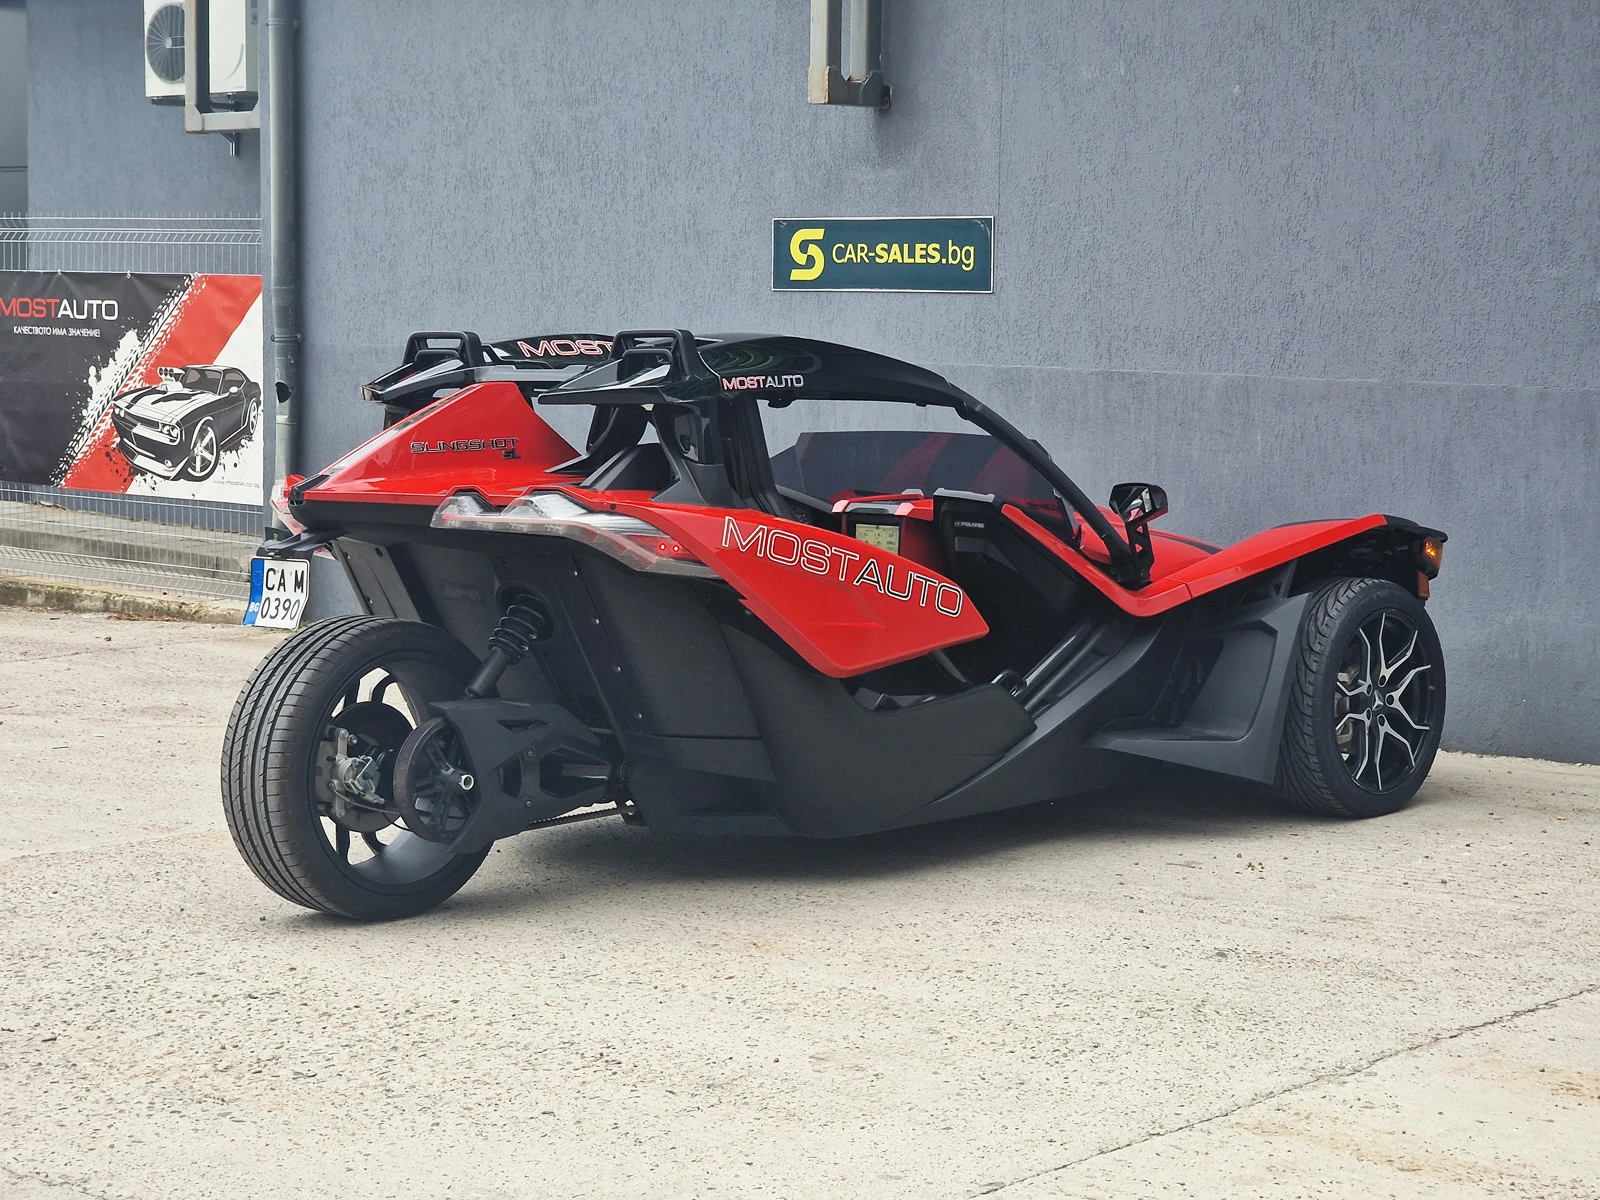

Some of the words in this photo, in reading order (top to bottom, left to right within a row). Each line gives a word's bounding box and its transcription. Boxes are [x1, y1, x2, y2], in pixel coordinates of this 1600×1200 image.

[832, 240, 975, 271] CAR-SALES.bg
[0, 297, 119, 320] MOSTAUTO
[13, 326, 51, 335] КАЧЕСТВОТО
[52, 327, 67, 336] ИМА
[722, 375, 804, 390] MOSTAUTO
[410, 437, 519, 454] SLINGSHOT
[722, 516, 963, 617] MOSTAUTO
[248, 602, 260, 612] BG
[260, 597, 301, 621] 0390
